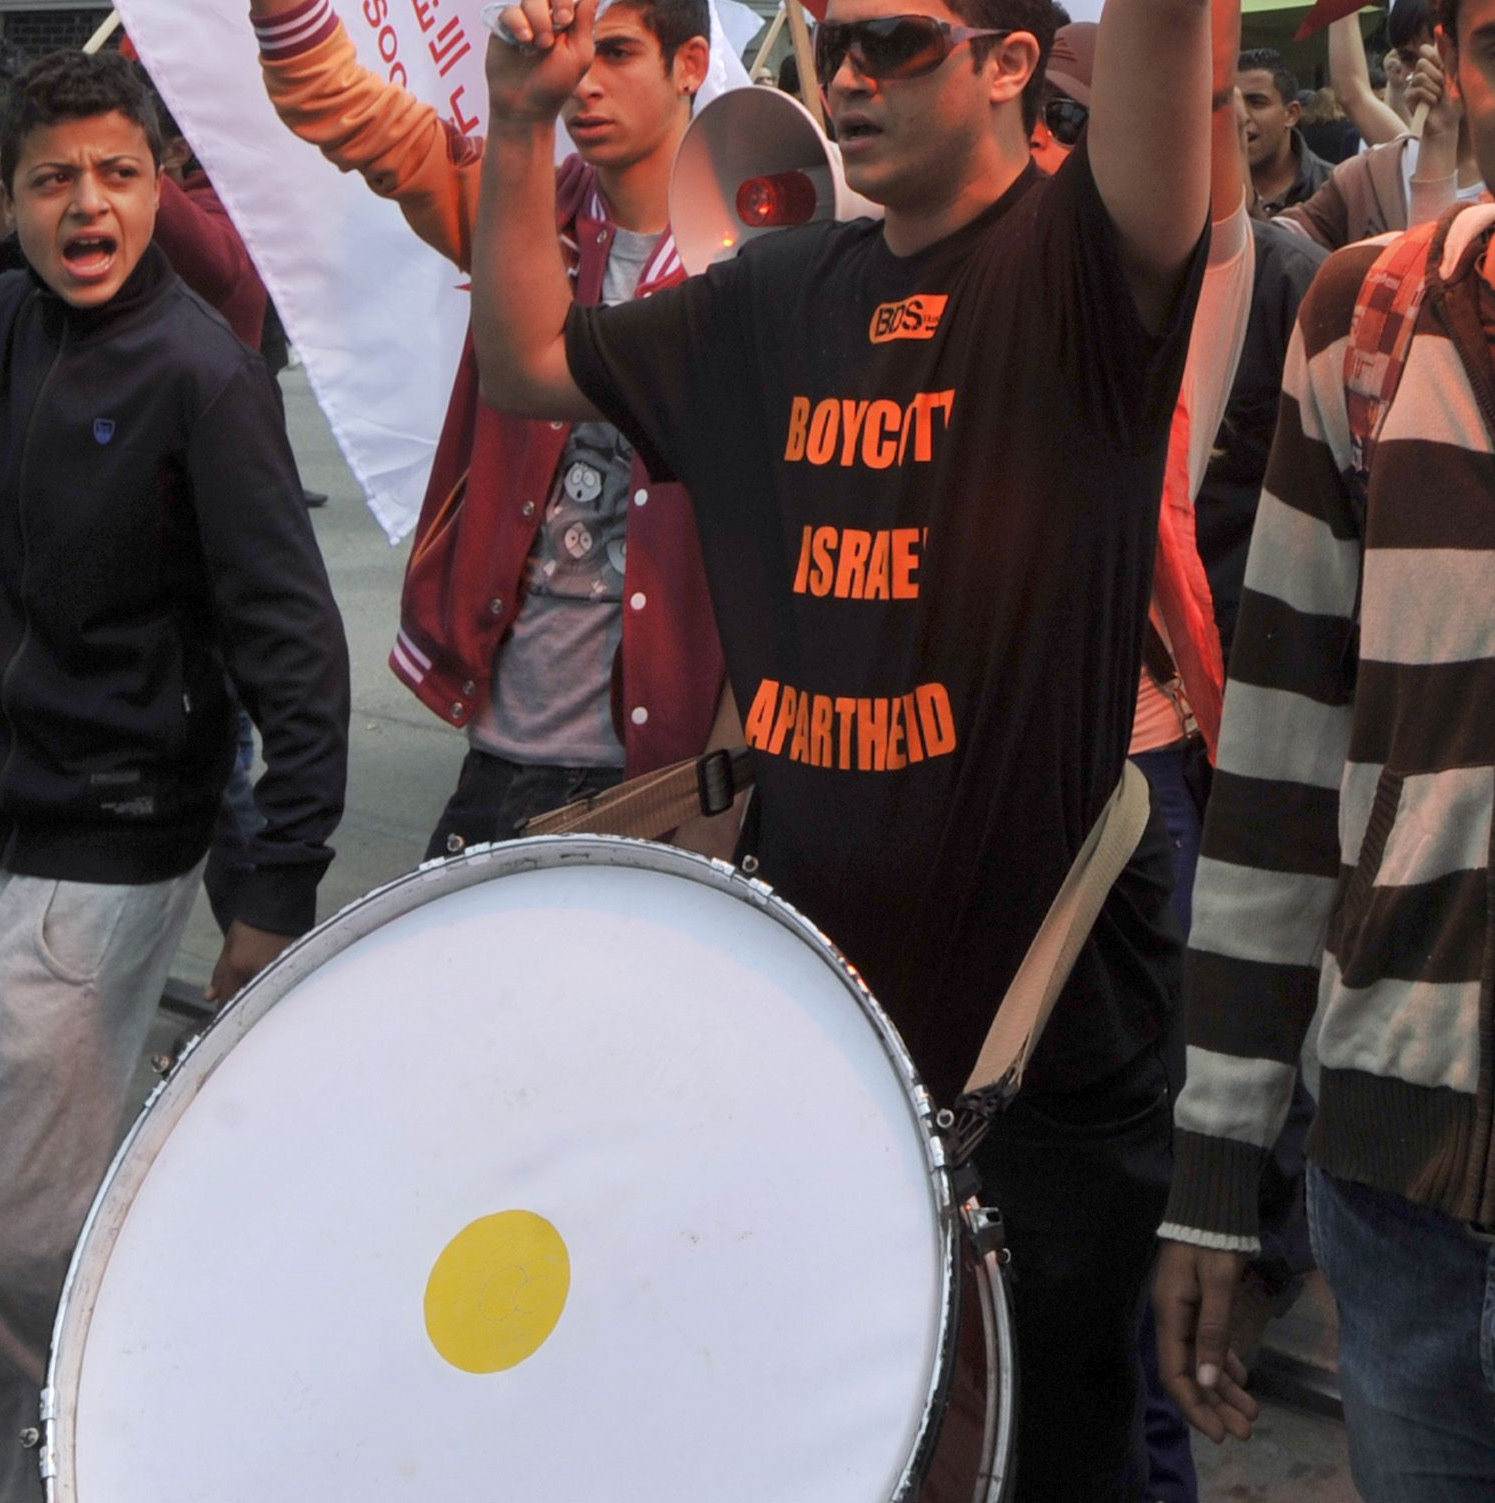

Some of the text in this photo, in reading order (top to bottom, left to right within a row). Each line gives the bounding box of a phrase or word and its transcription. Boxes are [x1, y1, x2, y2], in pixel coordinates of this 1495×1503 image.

[875, 300, 924, 339] BDS
[793, 525, 929, 600] ISRAE
[745, 677, 957, 772] APARTHEID
